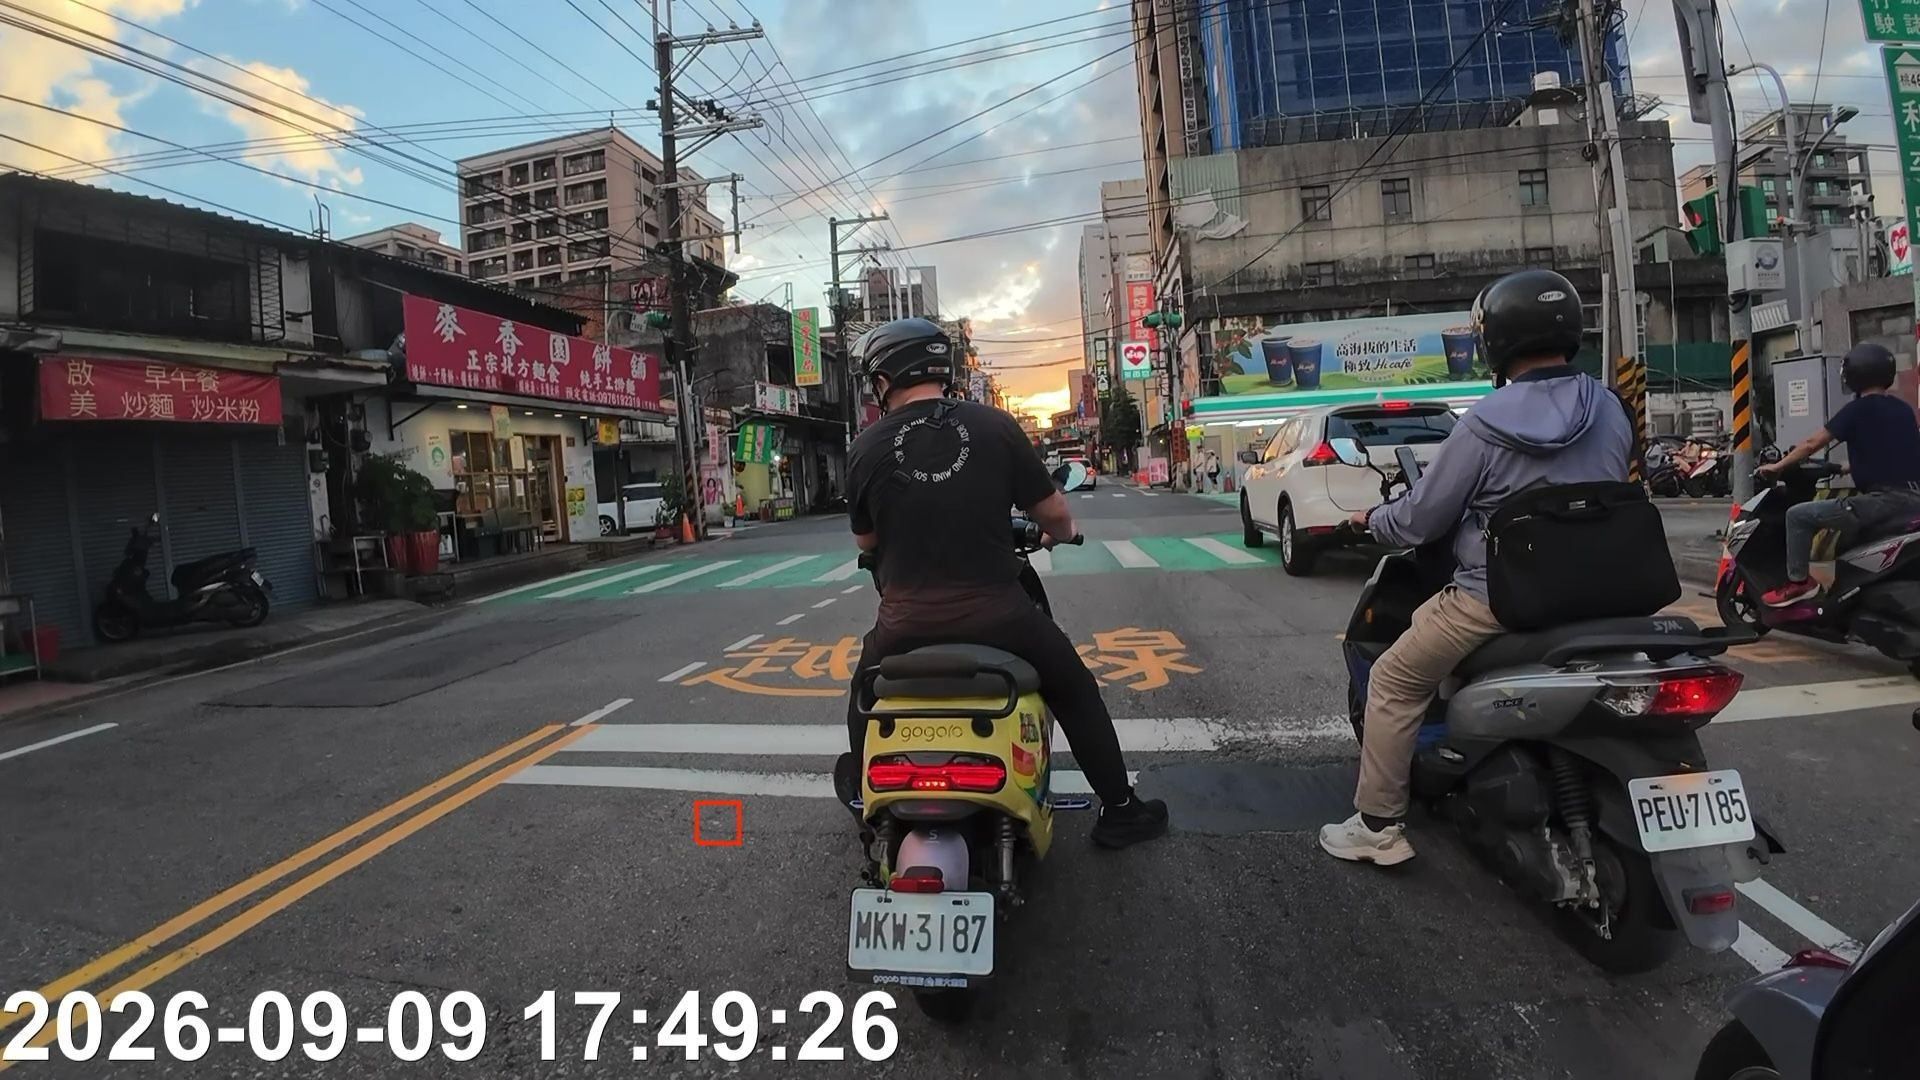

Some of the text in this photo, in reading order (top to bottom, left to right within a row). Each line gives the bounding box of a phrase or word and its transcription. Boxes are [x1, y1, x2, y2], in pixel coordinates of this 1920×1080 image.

[1336, 338, 1417, 357] 高海拔的生活
[144, 366, 221, 393] 早午餐
[466, 349, 561, 384] 正宗北方麵食
[191, 394, 261, 424] 炒米粉
[951, 446, 970, 472] SOUND
[1653, 621, 1684, 633] SYM
[900, 723, 964, 742] gogoro
